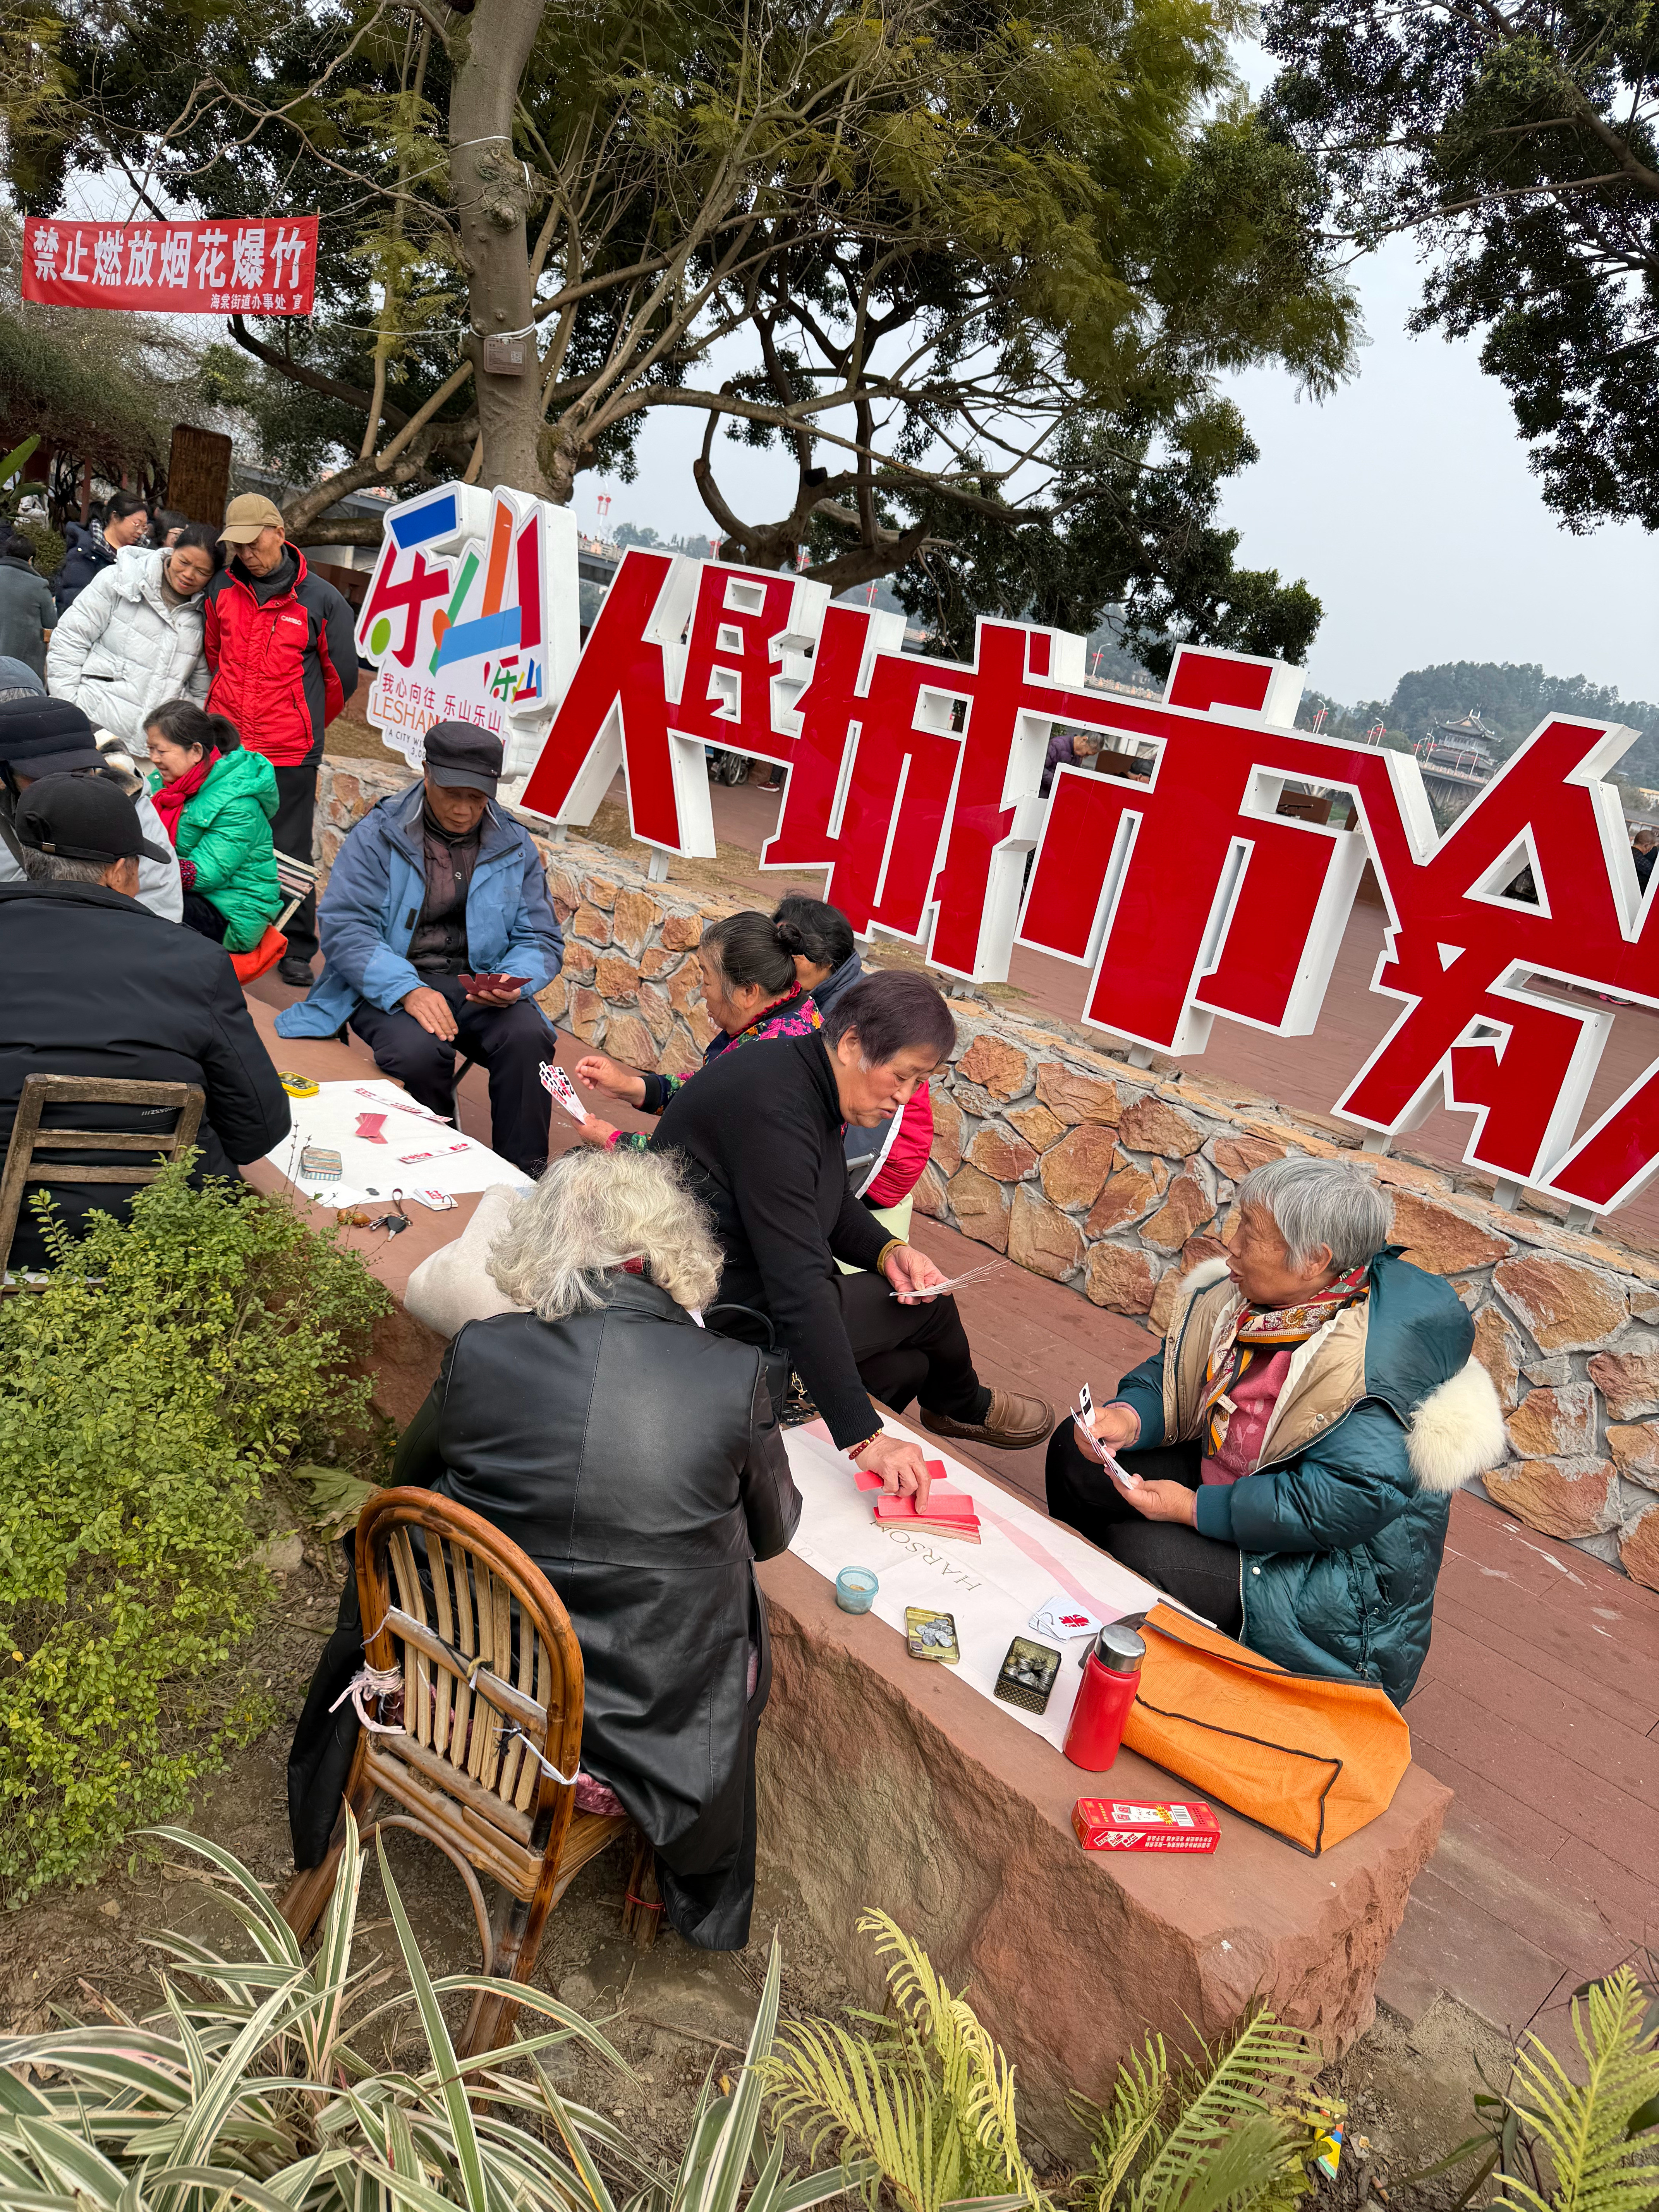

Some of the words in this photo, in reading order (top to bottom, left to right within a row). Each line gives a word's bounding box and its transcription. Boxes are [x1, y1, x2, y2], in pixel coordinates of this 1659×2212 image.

[34, 225, 306, 289] 禁止燃放烟花爆竹
[211, 293, 286, 310] 海棠街道办事处
[292, 294, 302, 310] 宣
[382, 673, 436, 709] 我心向往
[443, 694, 501, 733] 乐山乐山
[396, 731, 410, 743] CITY
[522, 549, 1659, 1214] 人民城市为
